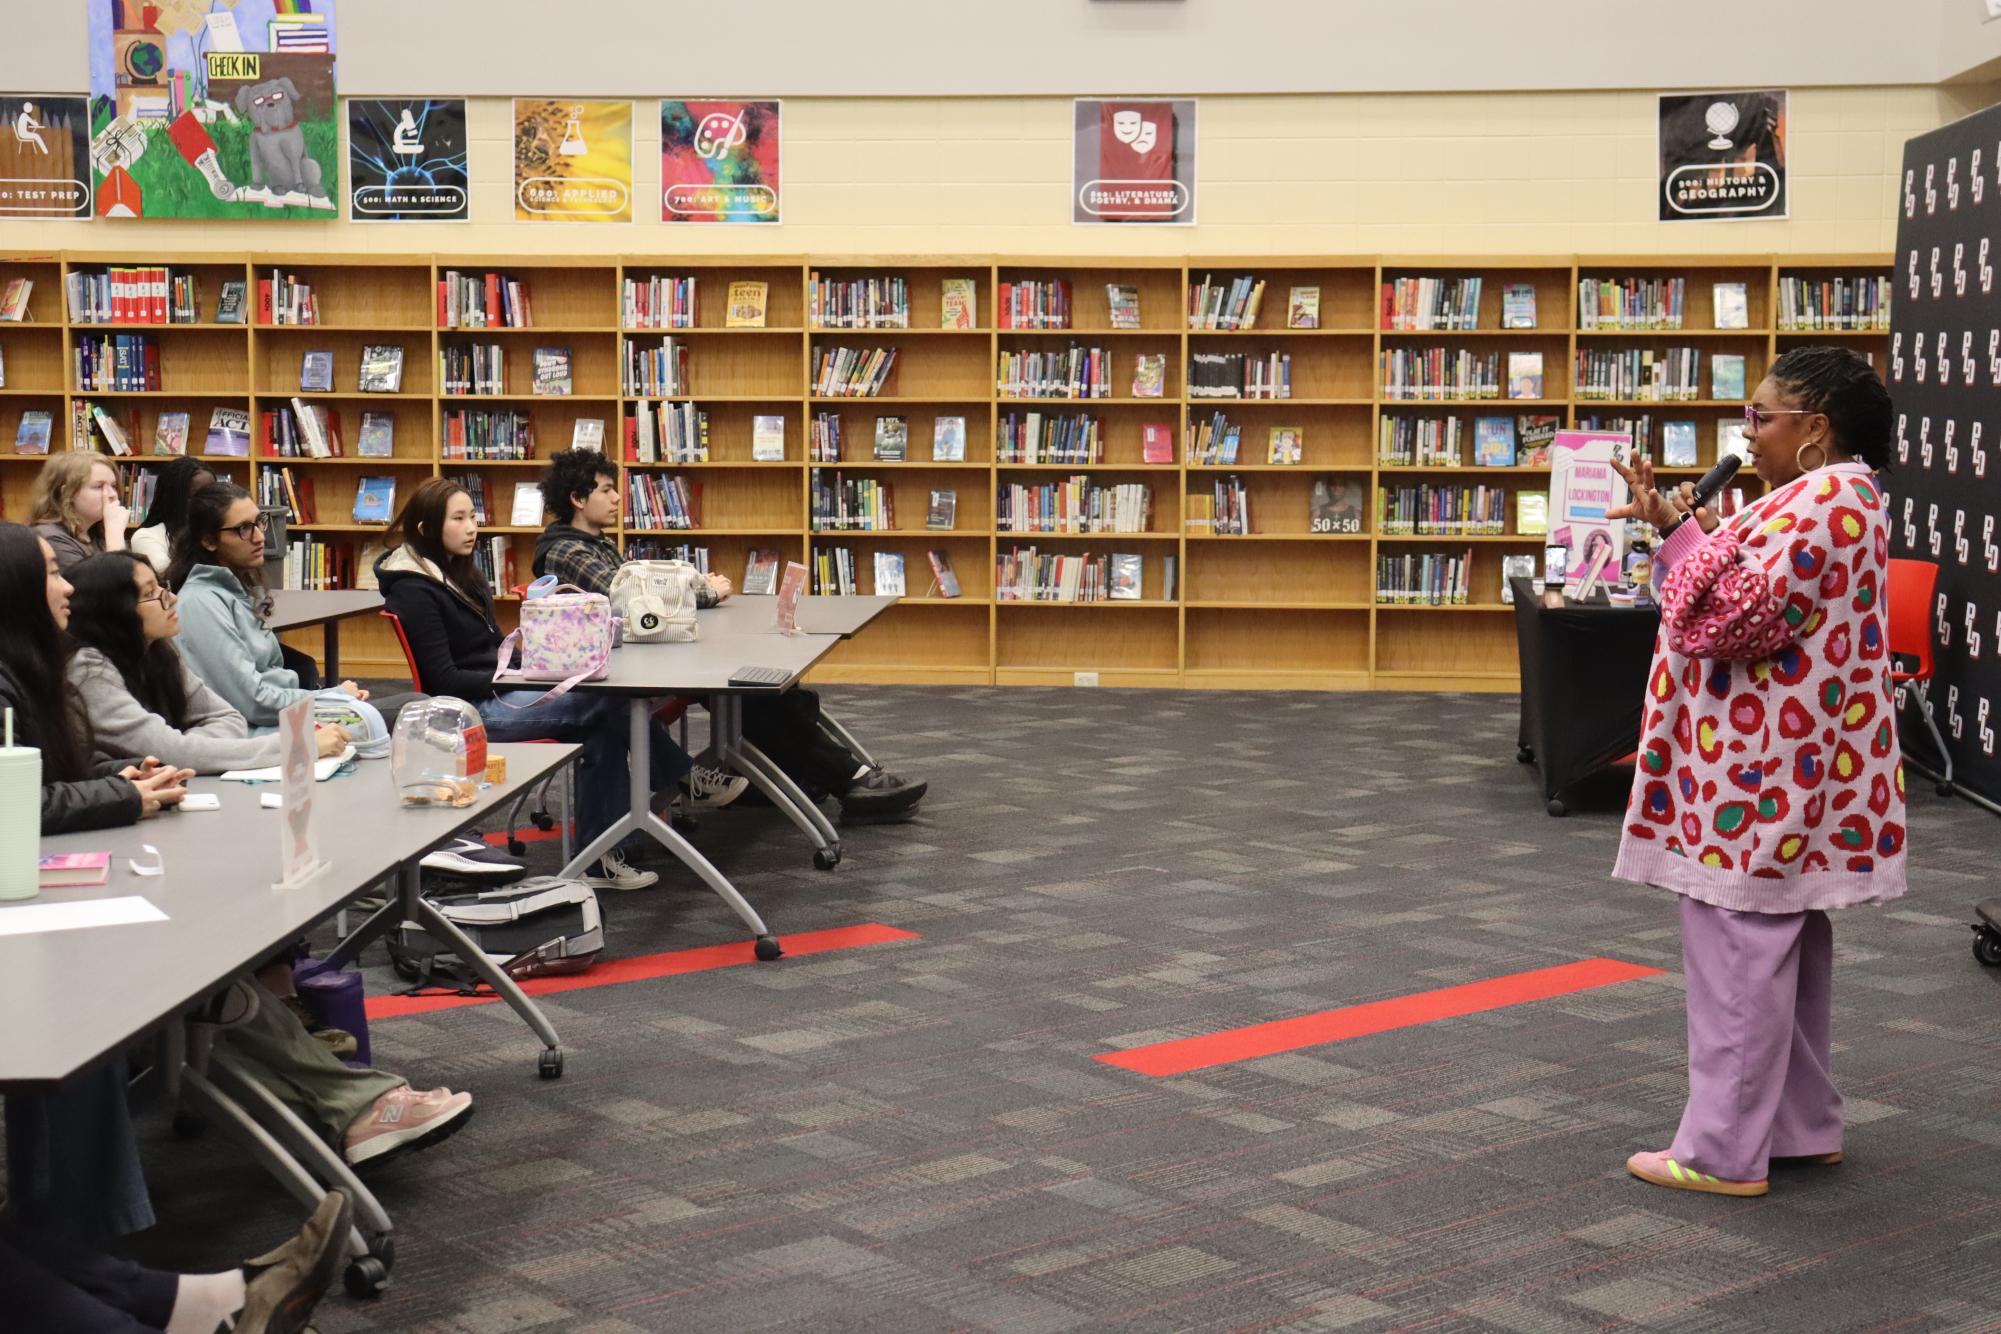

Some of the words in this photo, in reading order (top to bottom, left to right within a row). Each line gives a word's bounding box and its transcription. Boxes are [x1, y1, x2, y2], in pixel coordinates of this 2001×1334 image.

[210, 56, 240, 77] CHECK
[242, 56, 257, 77] IN
[1706, 176, 1755, 186] HISTORY
[1759, 175, 1766, 184] &
[17, 190, 46, 199] TEST
[50, 191, 80, 200] PREP
[385, 195, 409, 203] MATH
[420, 195, 458, 203] SCIENCE
[564, 189, 618, 199] APPLIED
[735, 195, 767, 203] MUSIC
[1678, 186, 1767, 200] GEOGRAPHY
[119, 349, 128, 366] SAT
[1575, 466, 1607, 480] MARIAMA
[1568, 488, 1611, 503] LOCKINGTON
